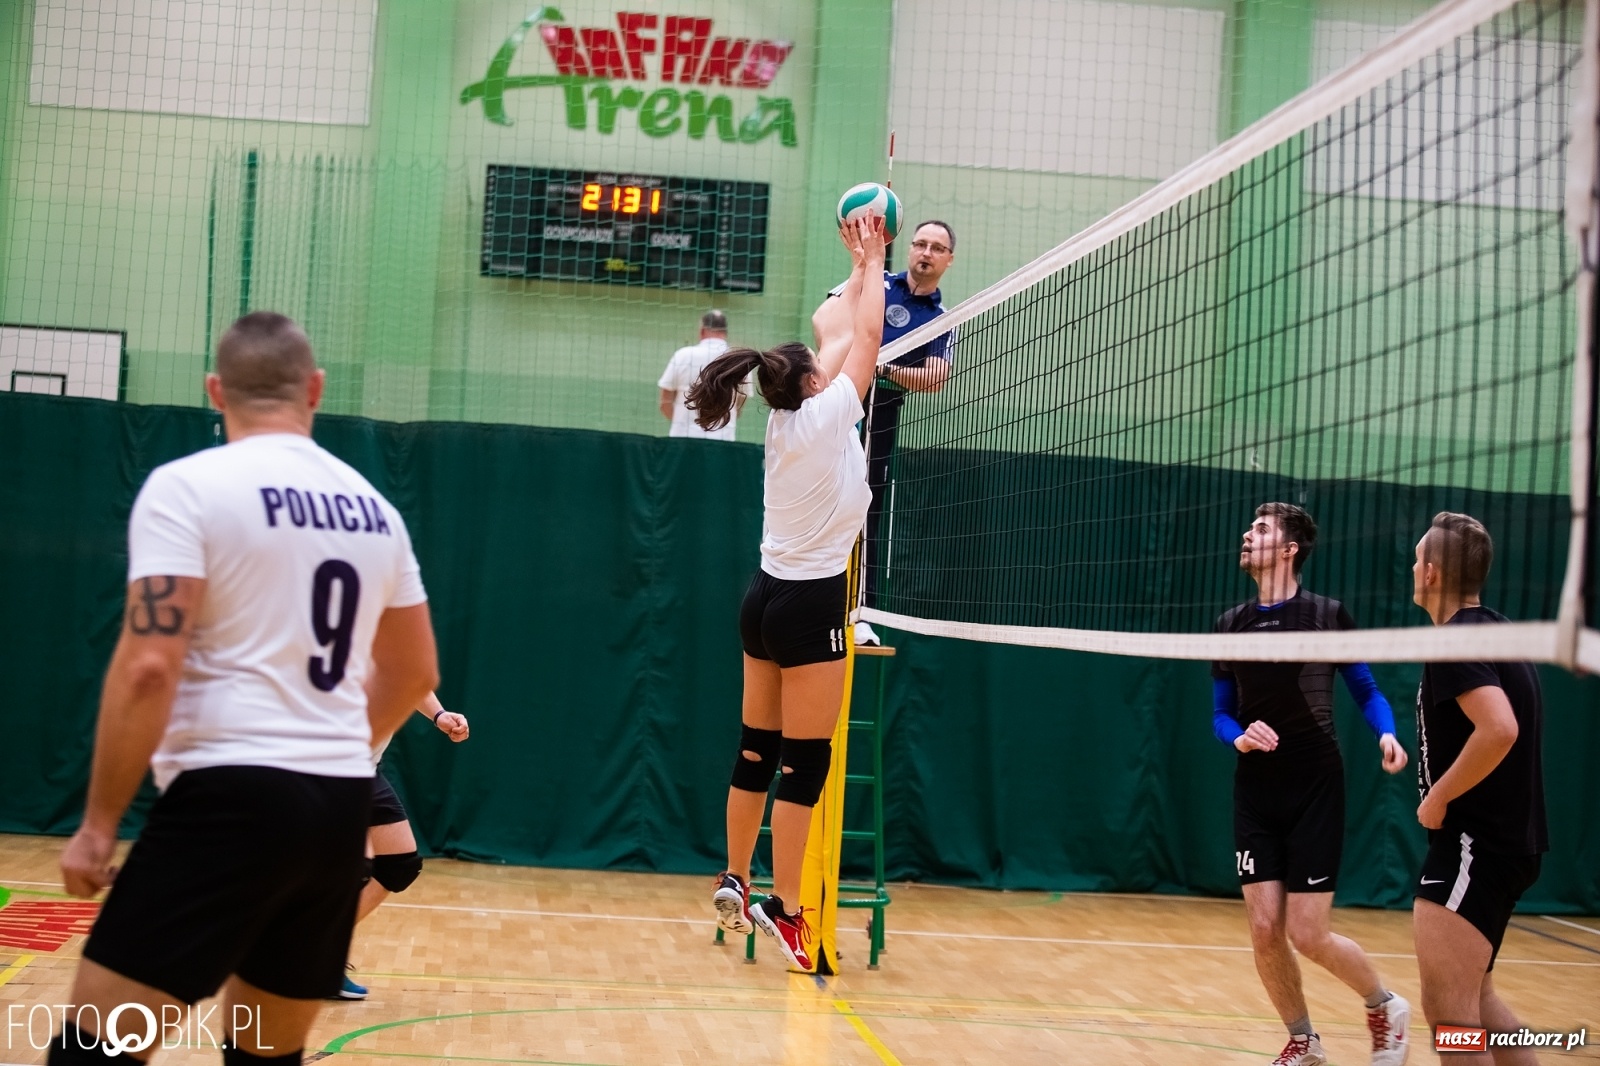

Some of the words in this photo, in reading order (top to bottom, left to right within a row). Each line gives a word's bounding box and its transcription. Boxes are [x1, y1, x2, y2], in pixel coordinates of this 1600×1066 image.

[459, 6, 798, 148] Arena
[260, 487, 391, 535] POLICJA
[307, 559, 361, 692] 9
[829, 628, 843, 652] 11
